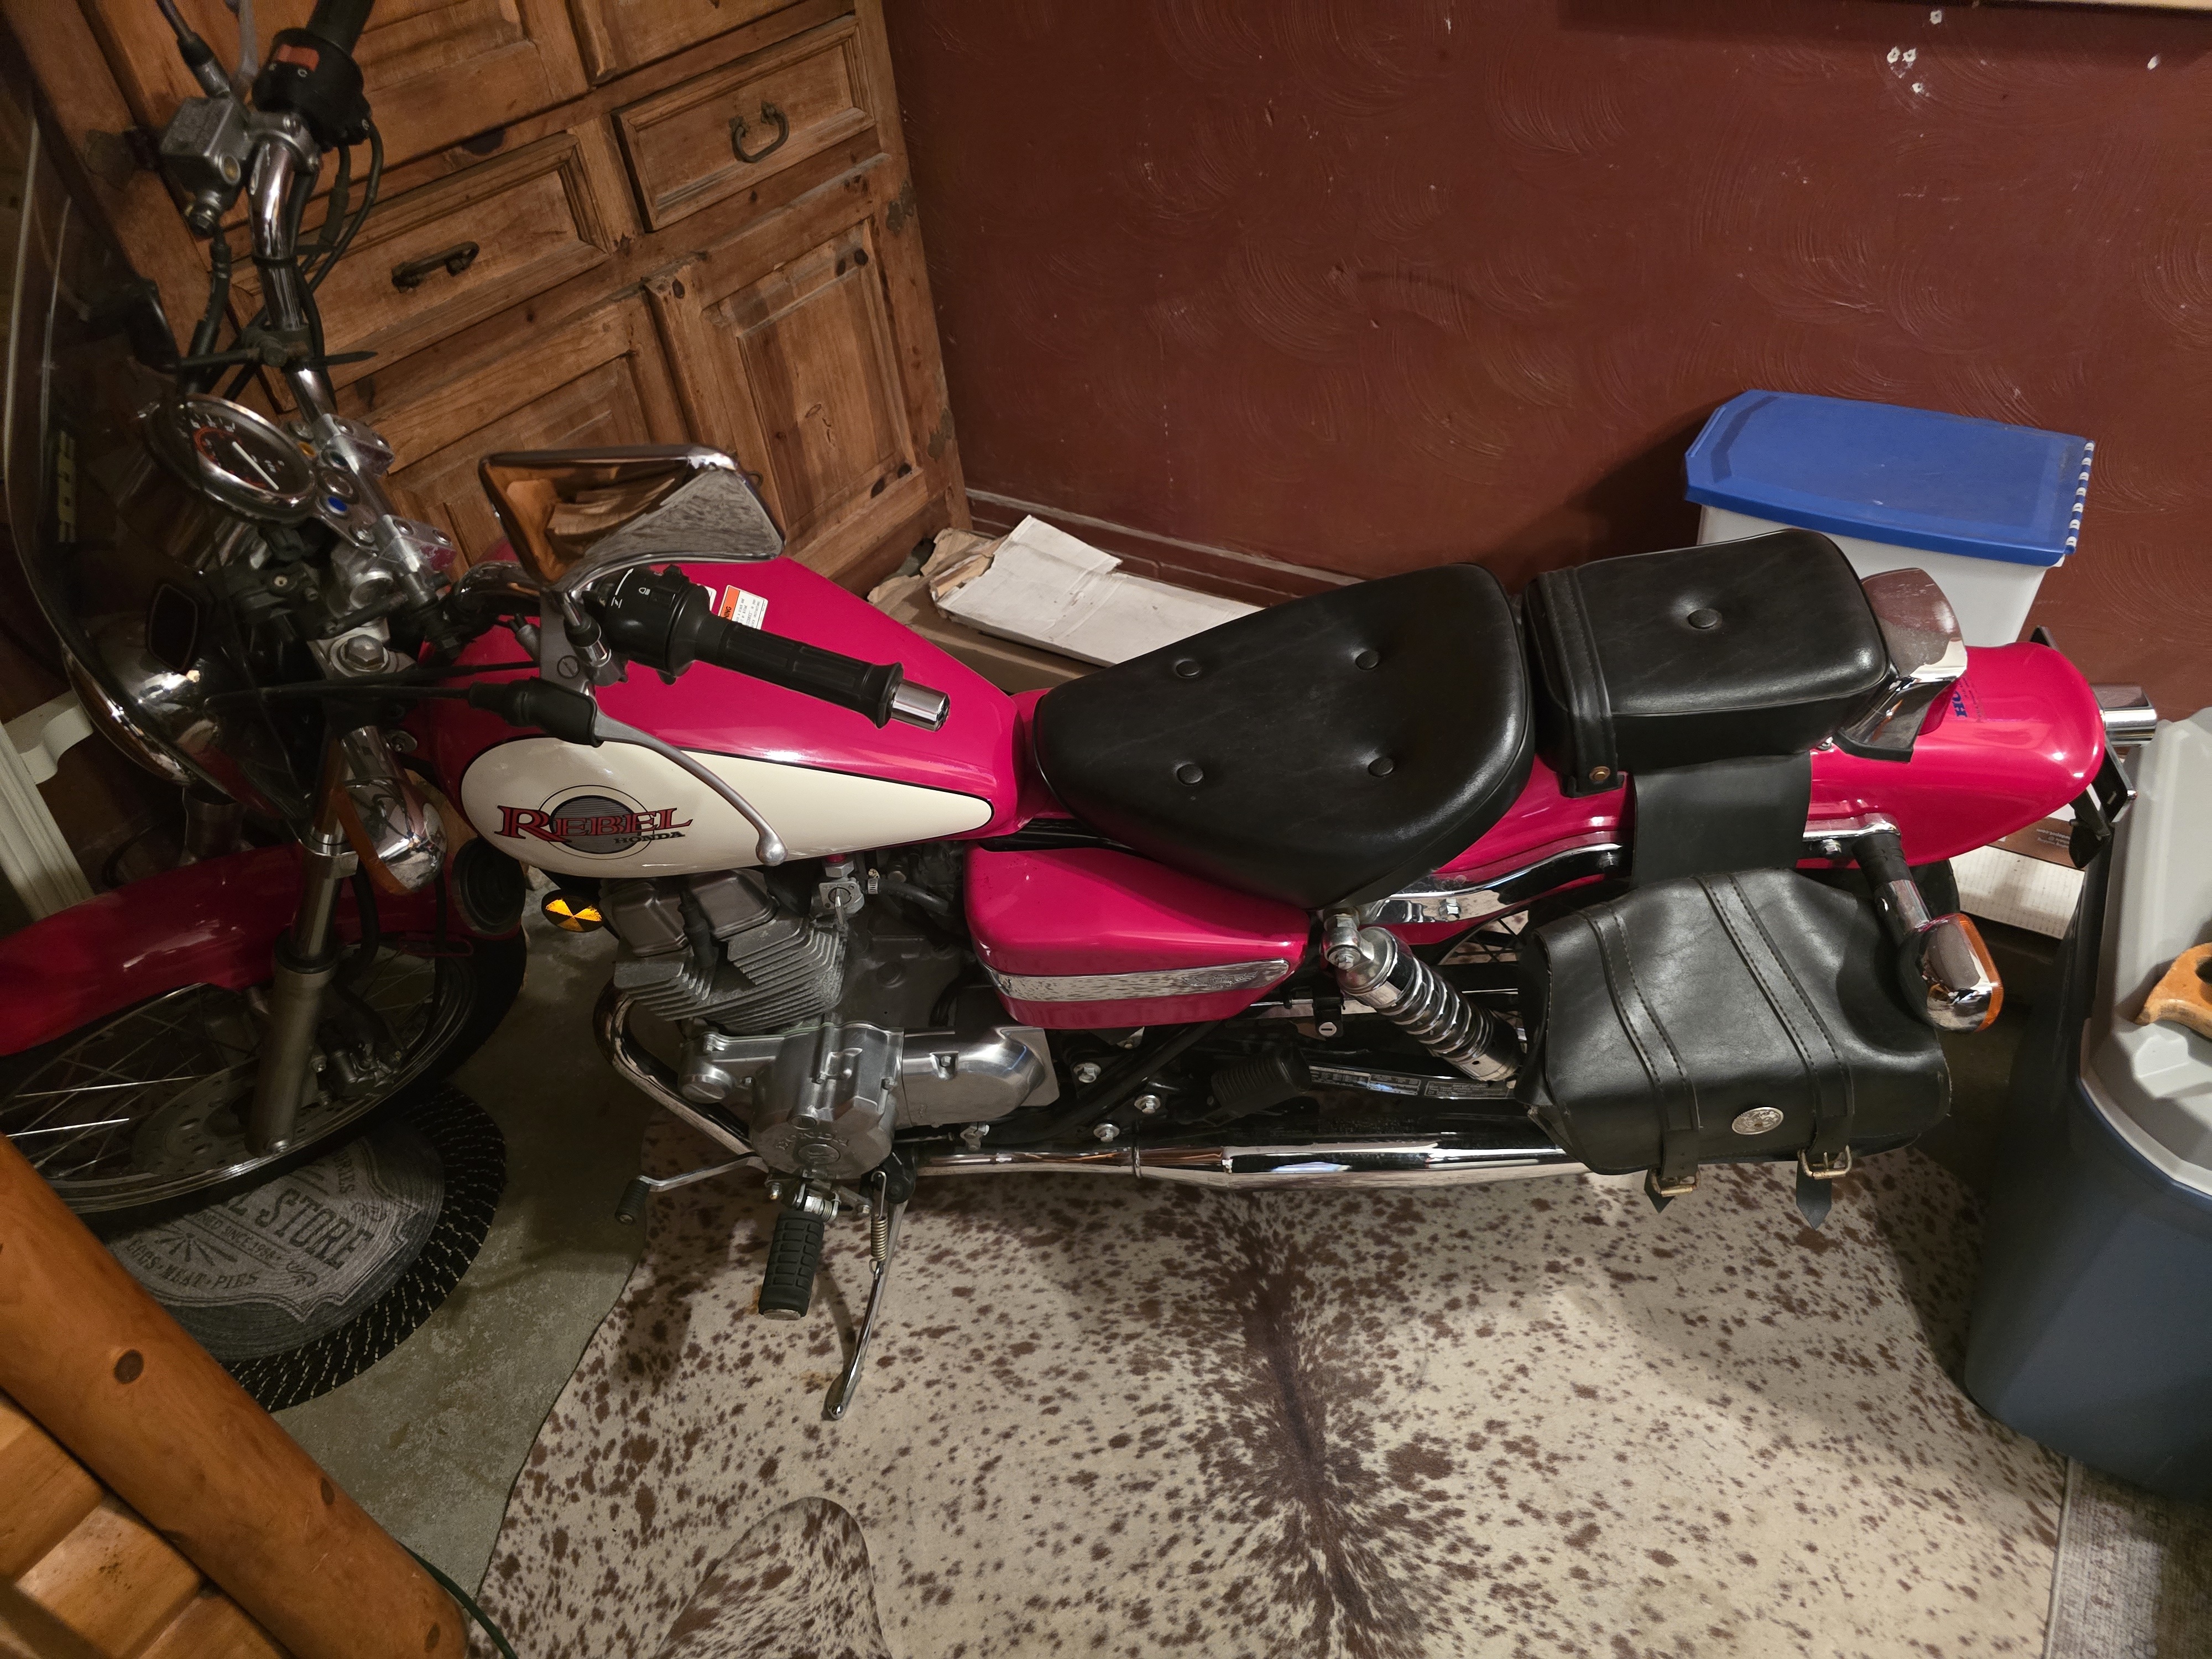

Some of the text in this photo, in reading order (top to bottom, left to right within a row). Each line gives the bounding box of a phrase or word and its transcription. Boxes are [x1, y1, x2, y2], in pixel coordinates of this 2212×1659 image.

[494, 805, 693, 843] REBEL
[614, 831, 686, 844] HONDA
[221, 1225, 254, 1247] SINCE
[254, 1188, 375, 1270] STORE
[210, 1271, 259, 1290] PIES
